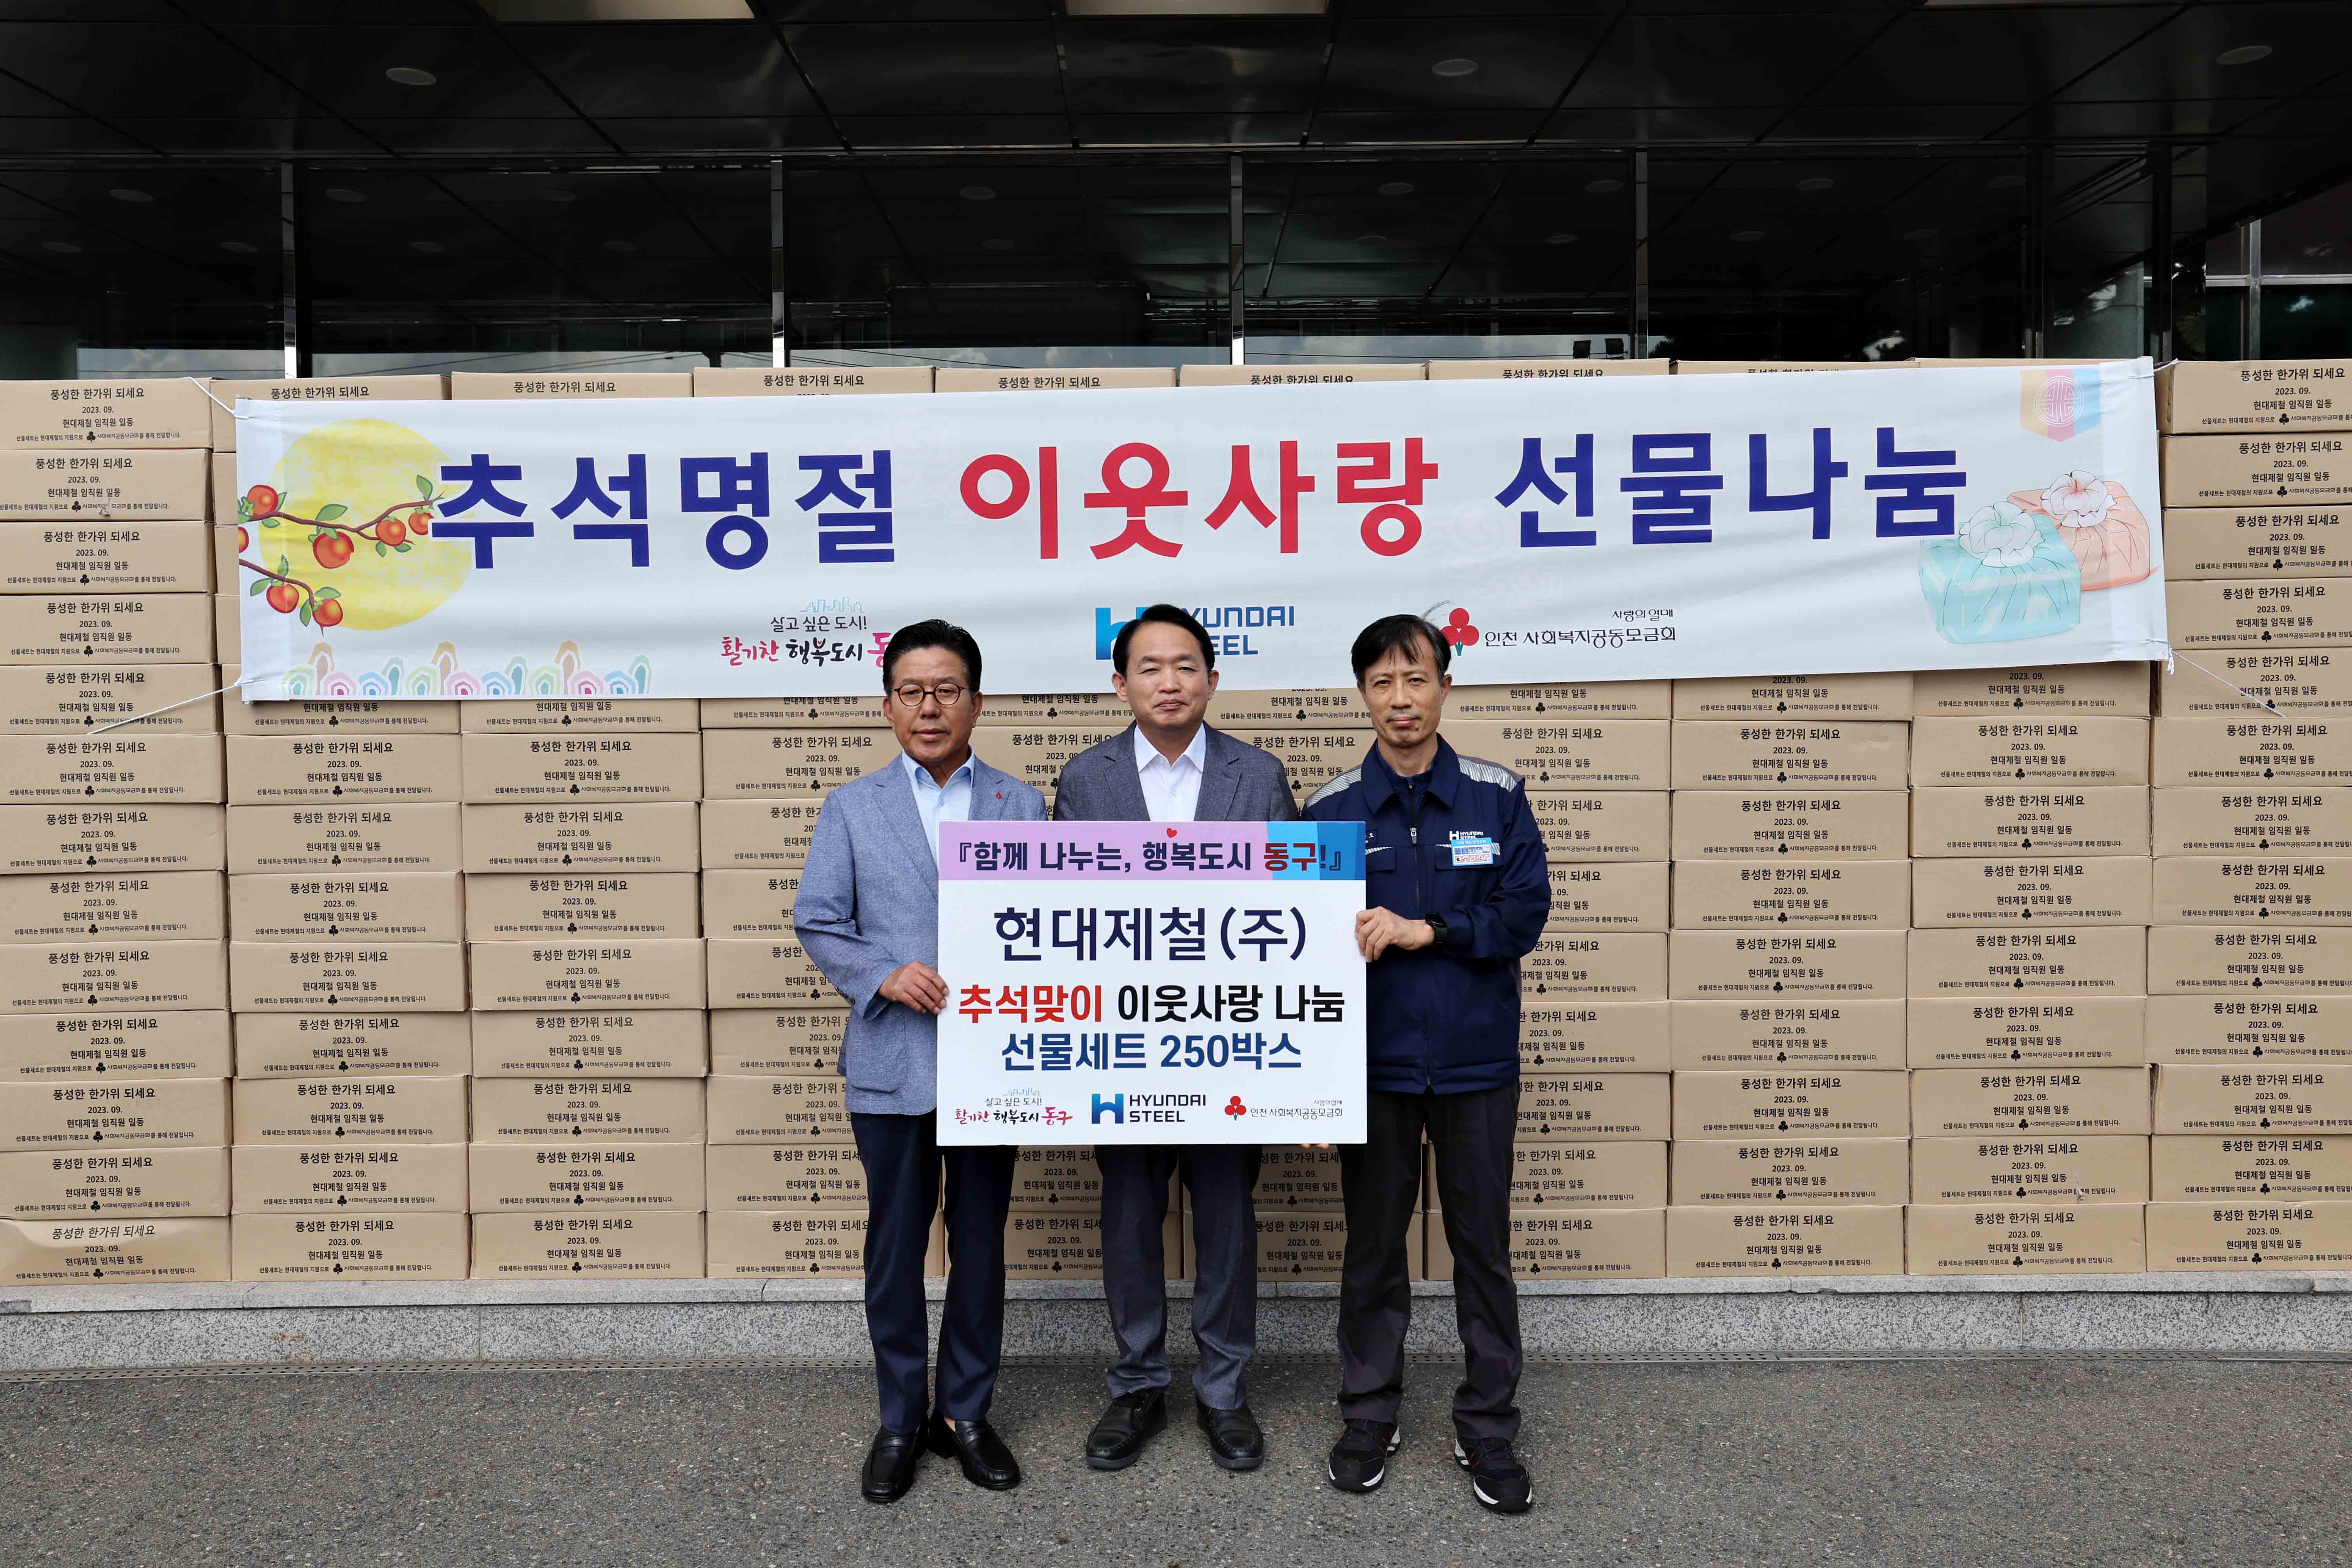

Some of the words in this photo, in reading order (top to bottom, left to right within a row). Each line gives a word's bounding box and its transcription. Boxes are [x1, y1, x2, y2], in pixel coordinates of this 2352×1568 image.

[763, 374, 795, 387] 풍성한
[798, 374, 829, 387] 한가위
[833, 374, 865, 387] 되세요
[998, 377, 1030, 389] 풍성한
[1033, 377, 1064, 388] 한가위
[1069, 376, 1101, 388] 되세요
[50, 388, 80, 400] 풍성한
[83, 388, 111, 399] 한가위
[115, 387, 145, 399] 되세요
[62, 419, 91, 428] 현대제철
[94, 418, 116, 427] 임직원
[119, 417, 134, 427] 일동
[430, 450, 895, 570] 추석명절
[960, 437, 1438, 559] 이웃사랑
[1495, 427, 1966, 548] 선물나눔
[2222, 588, 2254, 600] 풍성한
[2258, 586, 2289, 599] 한가위
[2294, 586, 2326, 598] 되세요
[1181, 606, 1294, 628] YUNDAI
[1612, 609, 1646, 622] 사랑의
[1648, 609, 1673, 621] 열매
[770, 617, 799, 633] 살고
[802, 616, 831, 632] 싶은
[834, 615, 867, 631] 도시!
[2236, 618, 2268, 628] 현대제철
[2271, 617, 2294, 627] 임직원
[2298, 617, 2314, 626] 일동
[1485, 632, 1517, 647] 인천
[1523, 626, 1675, 649] 사회복지공동모금회
[721, 636, 779, 666] 활기찬
[785, 639, 862, 667] 행복도시
[867, 632, 892, 668] 동
[530, 740, 562, 753] 풍성한
[565, 740, 596, 752] 한가위
[600, 740, 632, 752] 되세요
[544, 771, 575, 781] 현대제철
[578, 771, 602, 780] 임직원
[604, 771, 621, 780] 일동
[1984, 795, 2015, 807] 풍성한
[2019, 795, 2049, 806] 한가위
[2053, 795, 2085, 806] 되세요
[1996, 826, 2028, 835] 현대제철
[2031, 825, 2054, 835] 임직원
[2057, 825, 2073, 835] 일동
[959, 841, 1028, 871] 『함께
[1040, 842, 1131, 873] 나누는,
[1142, 841, 1251, 871] 행복도시
[994, 906, 1306, 962] 현대제철(주)
[1736, 938, 1767, 950] 풍성한
[1771, 938, 1801, 950] 한가위
[1805, 938, 1837, 950] 되세요
[1748, 969, 1779, 978] 현대제철
[1782, 969, 1805, 978] 임직원
[1809, 969, 1824, 978] 일동
[959, 984, 1102, 1024] 추석맞이
[1118, 985, 1263, 1023] 이웃사랑
[1276, 985, 1345, 1022] 나눔
[57, 1020, 88, 1032] 풍성한
[91, 1019, 122, 1031] 한가위
[126, 1018, 158, 1030] 되세요
[69, 1049, 102, 1060] 현대제철
[104, 1049, 128, 1058] 임직원
[131, 1048, 147, 1058] 일동
[1002, 1033, 1147, 1071] 선물세트
[1160, 1032, 1301, 1070] 250박스
[985, 1098, 1002, 1107] 살고
[1004, 1097, 1020, 1107] 싶은
[1023, 1097, 1042, 1106] 도시!
[1129, 1094, 1206, 1107] HYUNDAI
[955, 1109, 989, 1125] 활기찬
[993, 1109, 1039, 1125] 행복도시
[1041, 1107, 1073, 1126] 동구
[1129, 1111, 1185, 1123] STEEL
[1250, 1108, 1267, 1117] 인천
[1269, 1108, 1342, 1120] 사회복지공동모금회
[1045, 1150, 1076, 1162] 한가위
[1024, 1180, 1054, 1190] 현대제철
[1057, 1180, 1080, 1190] 임직원
[1083, 1180, 1099, 1190] 일동
[295, 1221, 326, 1232] 풍성한
[329, 1220, 359, 1232] 한가위
[363, 1220, 394, 1231] 되세요
[308, 1251, 339, 1260] 현대제철
[342, 1250, 364, 1259] 임직원
[368, 1250, 383, 1259] 일동
